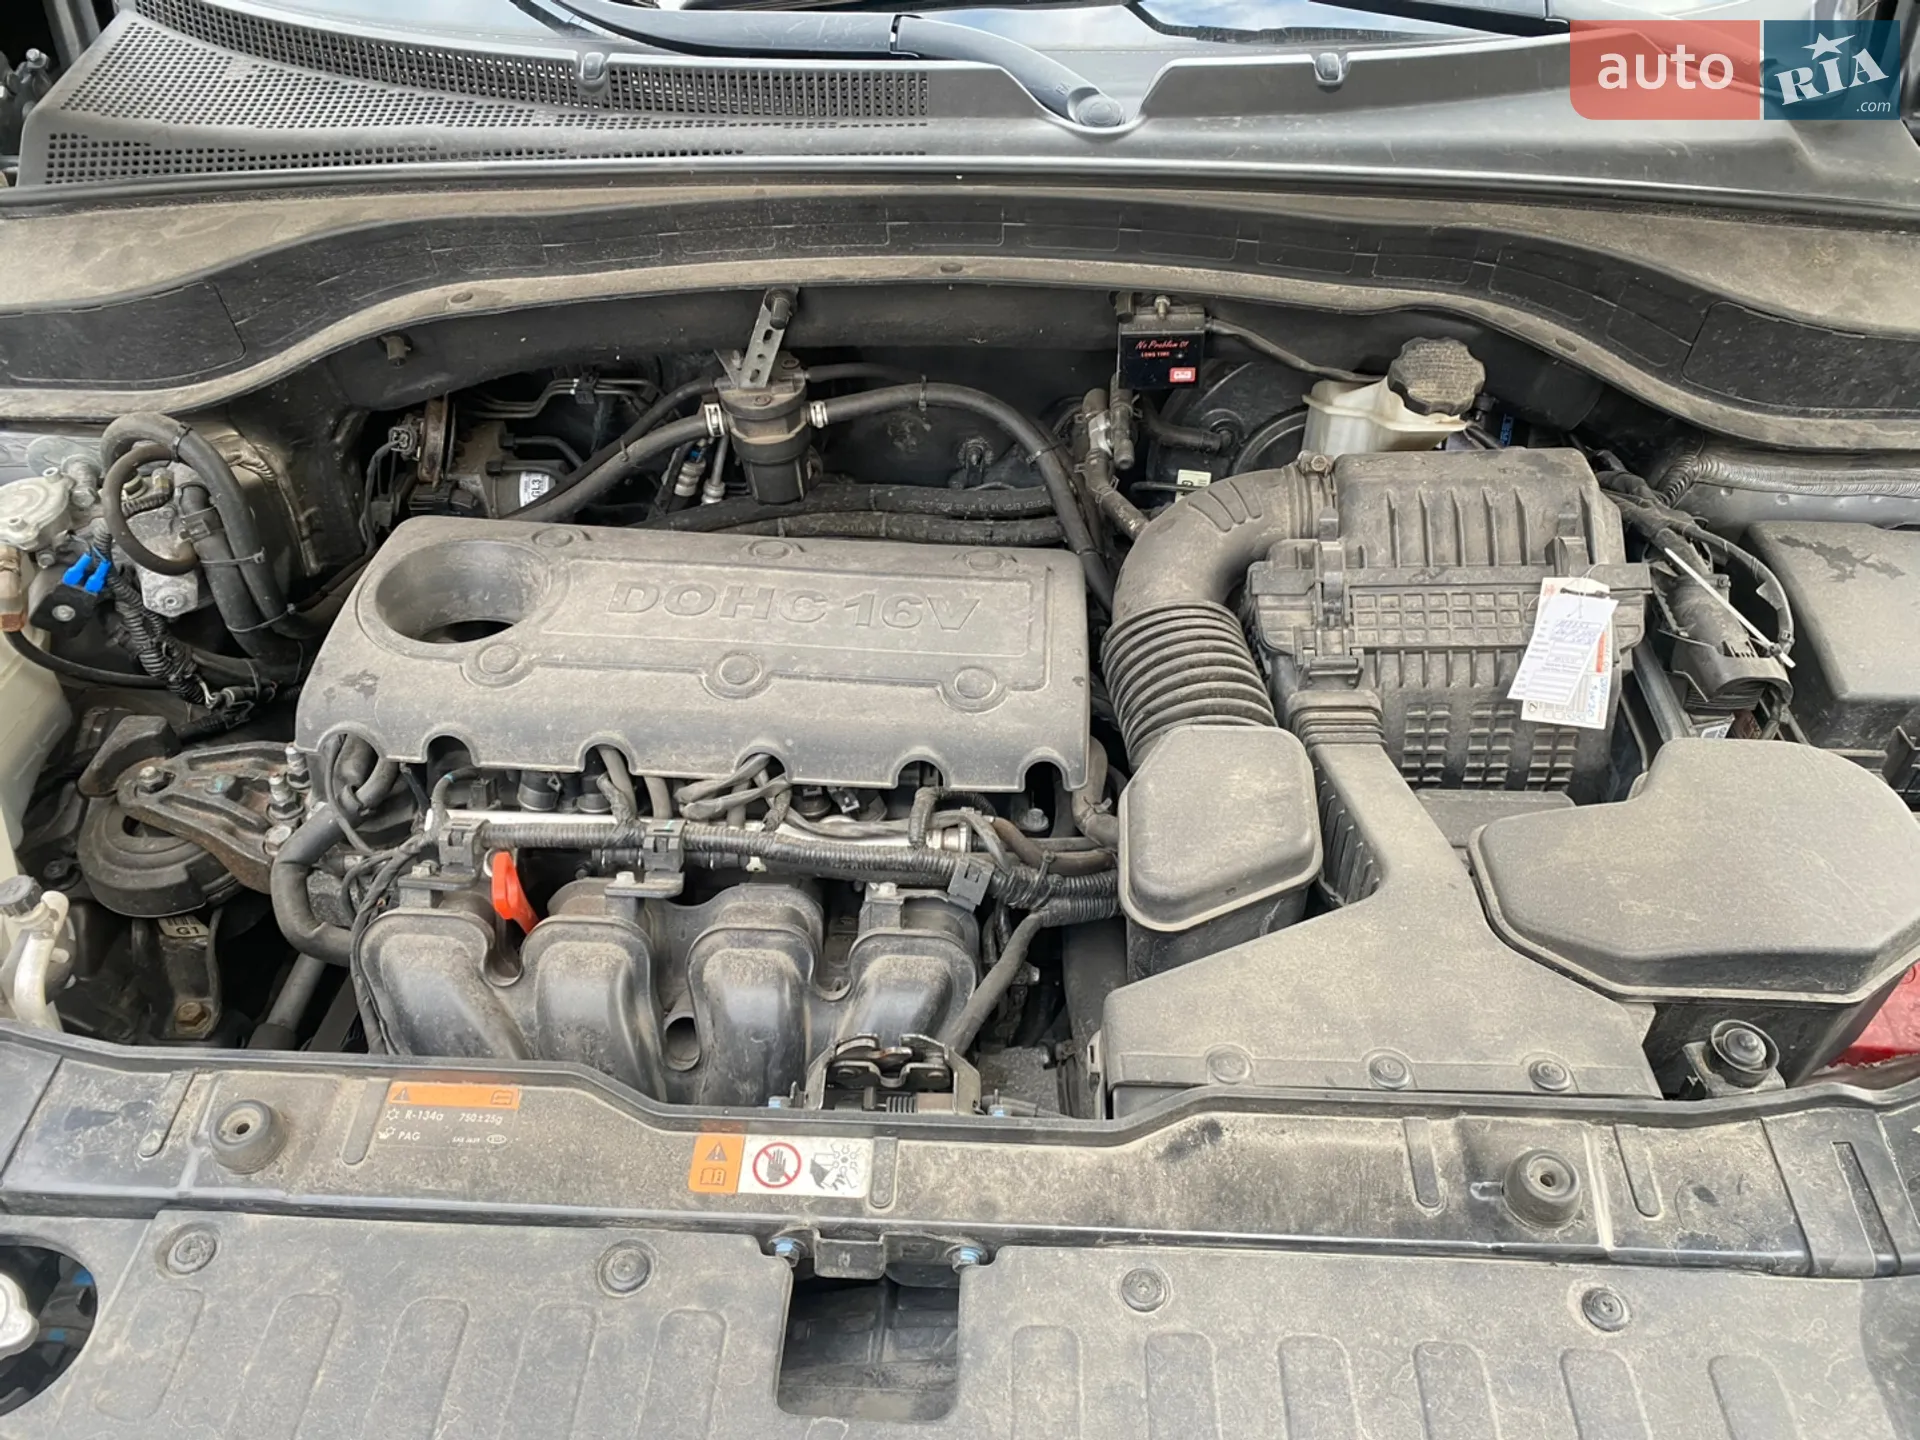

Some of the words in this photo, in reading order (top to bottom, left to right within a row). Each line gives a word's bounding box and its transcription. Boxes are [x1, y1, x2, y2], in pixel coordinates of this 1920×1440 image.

[606, 581, 828, 624] DOHC
[844, 593, 981, 631] 16V
[404, 1109, 444, 1121] R-134a
[458, 1112, 504, 1125] 750±25g
[398, 1130, 421, 1141] PAG
